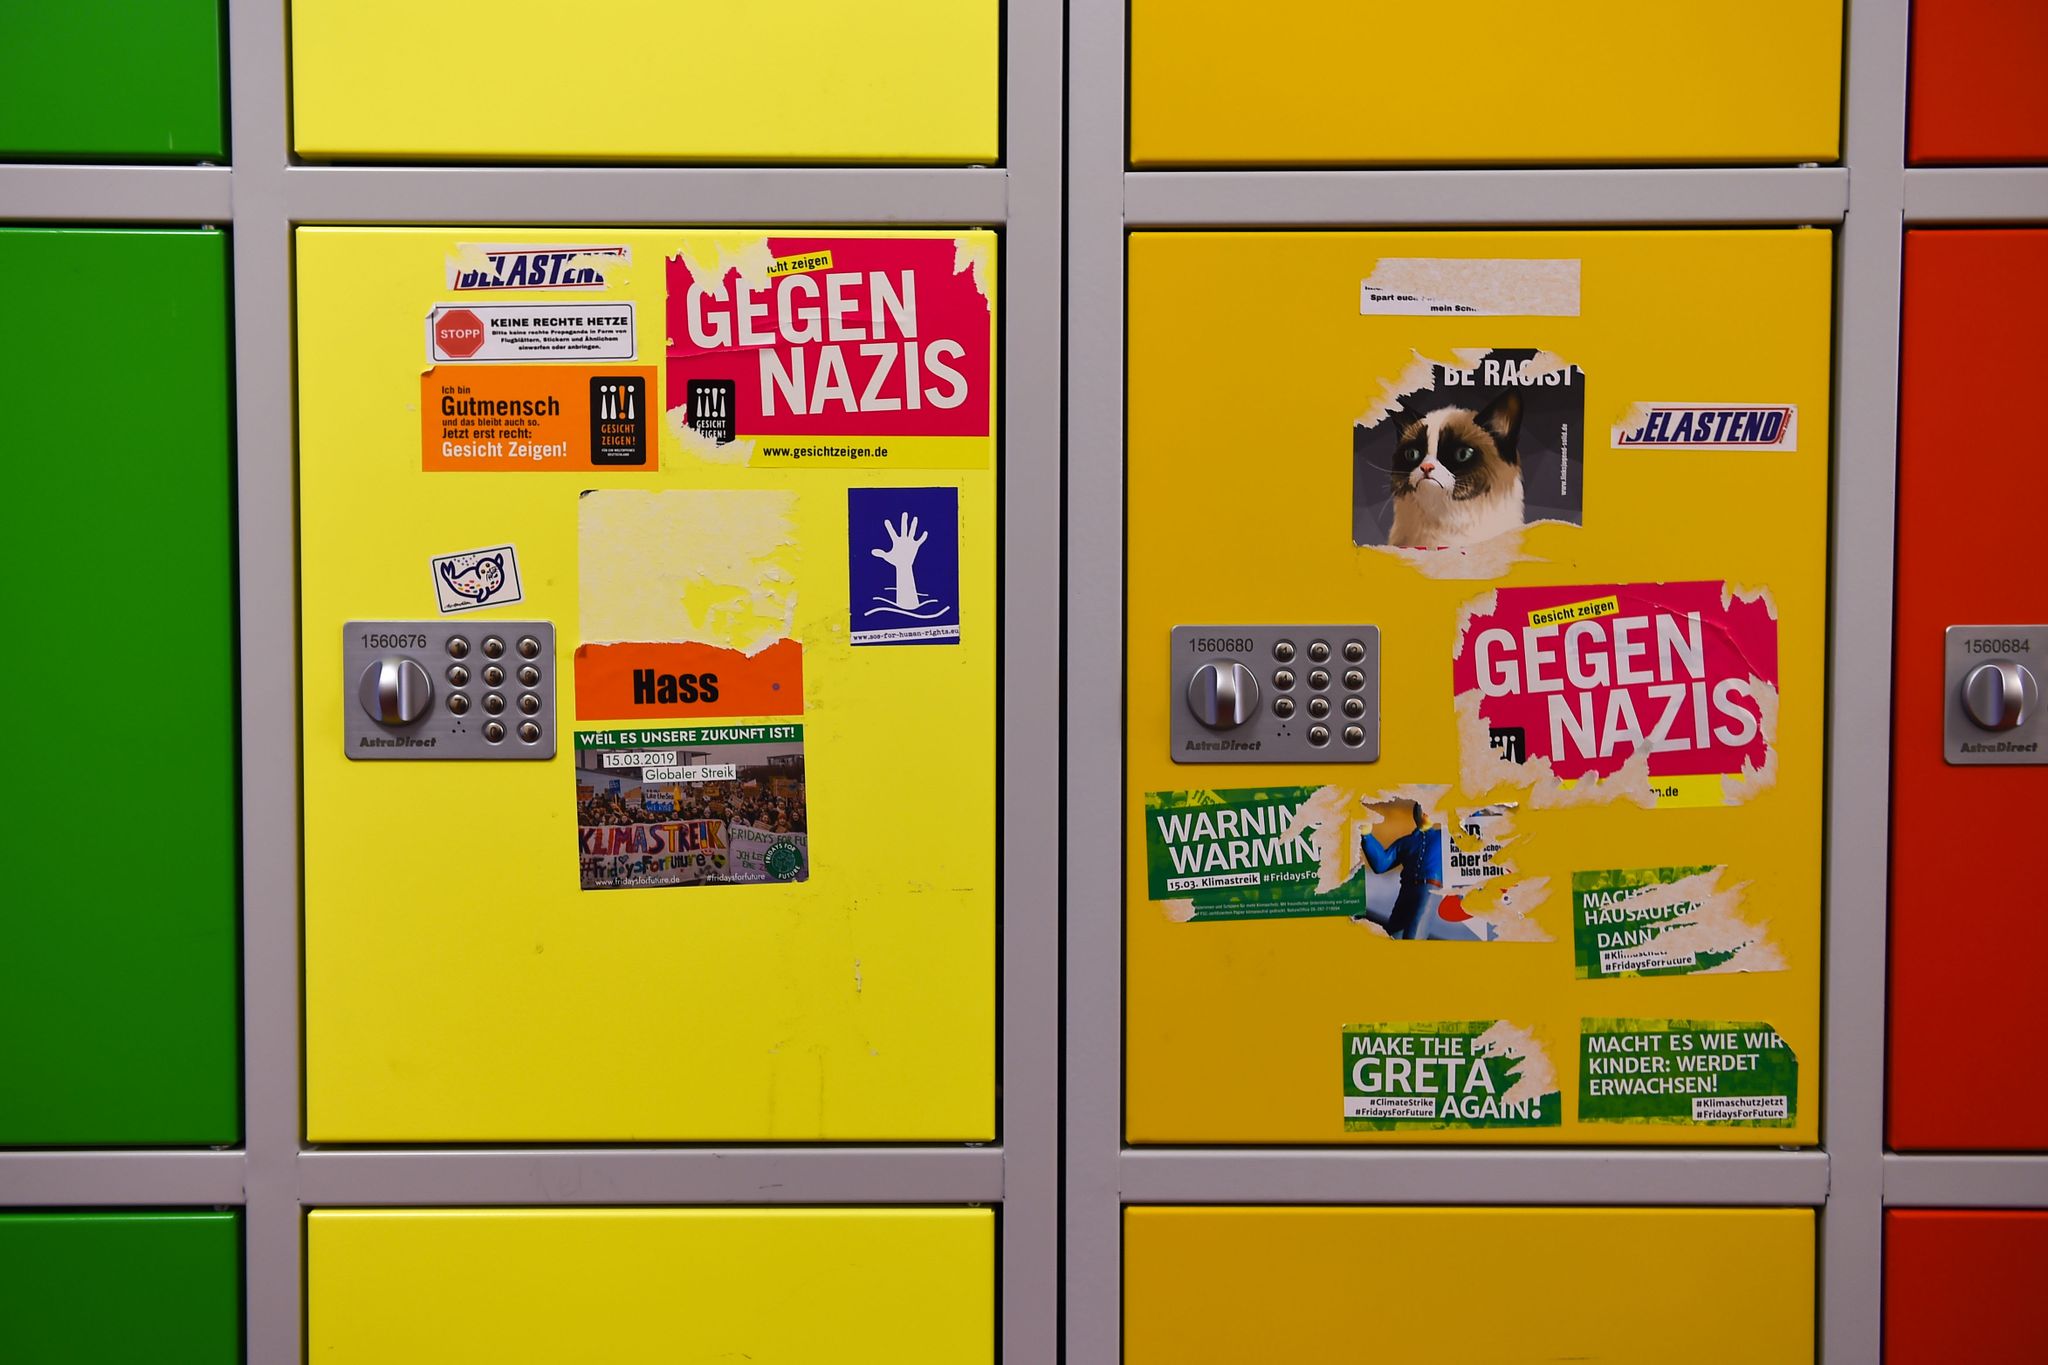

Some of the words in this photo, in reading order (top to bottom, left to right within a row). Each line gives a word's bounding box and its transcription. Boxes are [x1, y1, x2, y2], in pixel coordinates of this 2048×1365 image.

[792, 256, 828, 270] zeigen
[1370, 294, 1394, 302] Spart
[686, 269, 918, 348] GEGEN
[491, 318, 529, 327] KEINE
[533, 317, 583, 327] RECHTE
[587, 317, 629, 326] HETZE
[441, 329, 480, 340] STOPP
[758, 339, 968, 417] NAZIS
[1444, 364, 1475, 387] BE
[442, 386, 455, 394] Ich
[458, 386, 471, 394] bin
[442, 396, 560, 416] Gutmensch
[442, 418, 458, 427] und
[460, 418, 475, 426] das
[478, 418, 502, 426] bleibt
[504, 418, 525, 426] auch
[601, 424, 635, 434] GESICHT
[442, 428, 469, 439] Jetzt
[473, 429, 495, 439] erst
[499, 428, 532, 439] recht:
[601, 436, 636, 446] ZEIGEN!
[698, 430, 727, 439] EIGEN!
[442, 441, 503, 457] Gesicht
[508, 441, 567, 460] Zeigen!
[763, 446, 888, 459] www.gesichtzeigen.de
[1533, 607, 1575, 625] Gesicht
[1578, 600, 1615, 618] zeigen
[361, 634, 427, 649] 1560676
[853, 628, 959, 641] www.sos-for-human-rights.eu
[1189, 638, 1254, 653] 1560680
[1964, 639, 2030, 653] 1560684
[1474, 611, 1706, 697] GEGEN
[633, 669, 719, 705] Hass
[1547, 677, 1758, 762] NAZIS
[359, 736, 436, 748] AstraDirect
[580, 733, 616, 745] WEIL
[620, 732, 637, 744] ES
[641, 730, 697, 743] UNSERE
[701, 727, 765, 741] ZUKUNFT
[769, 726, 795, 739] IST!
[1185, 739, 1261, 751] AstraDirect
[1960, 742, 2038, 753] AstraDirect
[606, 753, 675, 766] 15.03.2019
[645, 767, 696, 780] Globaler
[701, 765, 735, 779] Streik
[1157, 803, 1302, 844] WARNIN
[578, 820, 727, 855] KLIMASTREIK
[730, 828, 773, 844] FRIDAYS
[765, 843, 783, 864] FRIDAYS
[784, 843, 796, 852] FOR
[1168, 835, 1320, 875] WARMIN
[1450, 853, 1481, 867] aber
[706, 872, 766, 883] #fridaysforfuture
[778, 865, 801, 880] FUTURE
[1169, 880, 1199, 891] 15.03.
[1201, 874, 1258, 888] Klimastreik
[1263, 870, 1318, 883] #FridaysFo
[1583, 889, 1636, 910] MACH
[1585, 901, 1705, 925] HAUSAUFGA
[1597, 928, 1652, 949] DANN
[1351, 1036, 1415, 1055] MAKE
[1419, 1037, 1464, 1056] THE
[1588, 1035, 1662, 1053] MACHT
[1669, 1034, 1693, 1051] ES
[1700, 1033, 1738, 1051] WIE
[1743, 1032, 1784, 1049] WIR
[1589, 1057, 1671, 1075] KINDER:
[1676, 1054, 1760, 1073] WERDET
[1352, 1057, 1496, 1095] GRETA
[1590, 1074, 1718, 1096] ERWACHSEN!
[1355, 1108, 1434, 1118] #FridaysForFuture
[1440, 1095, 1541, 1120] AGAIN!
[1370, 1098, 1434, 1107] #ClimateStrike
[1696, 1098, 1784, 1108] #KlimaschutzJetzt
[1696, 1109, 1784, 1119] #FridaysForFuture
